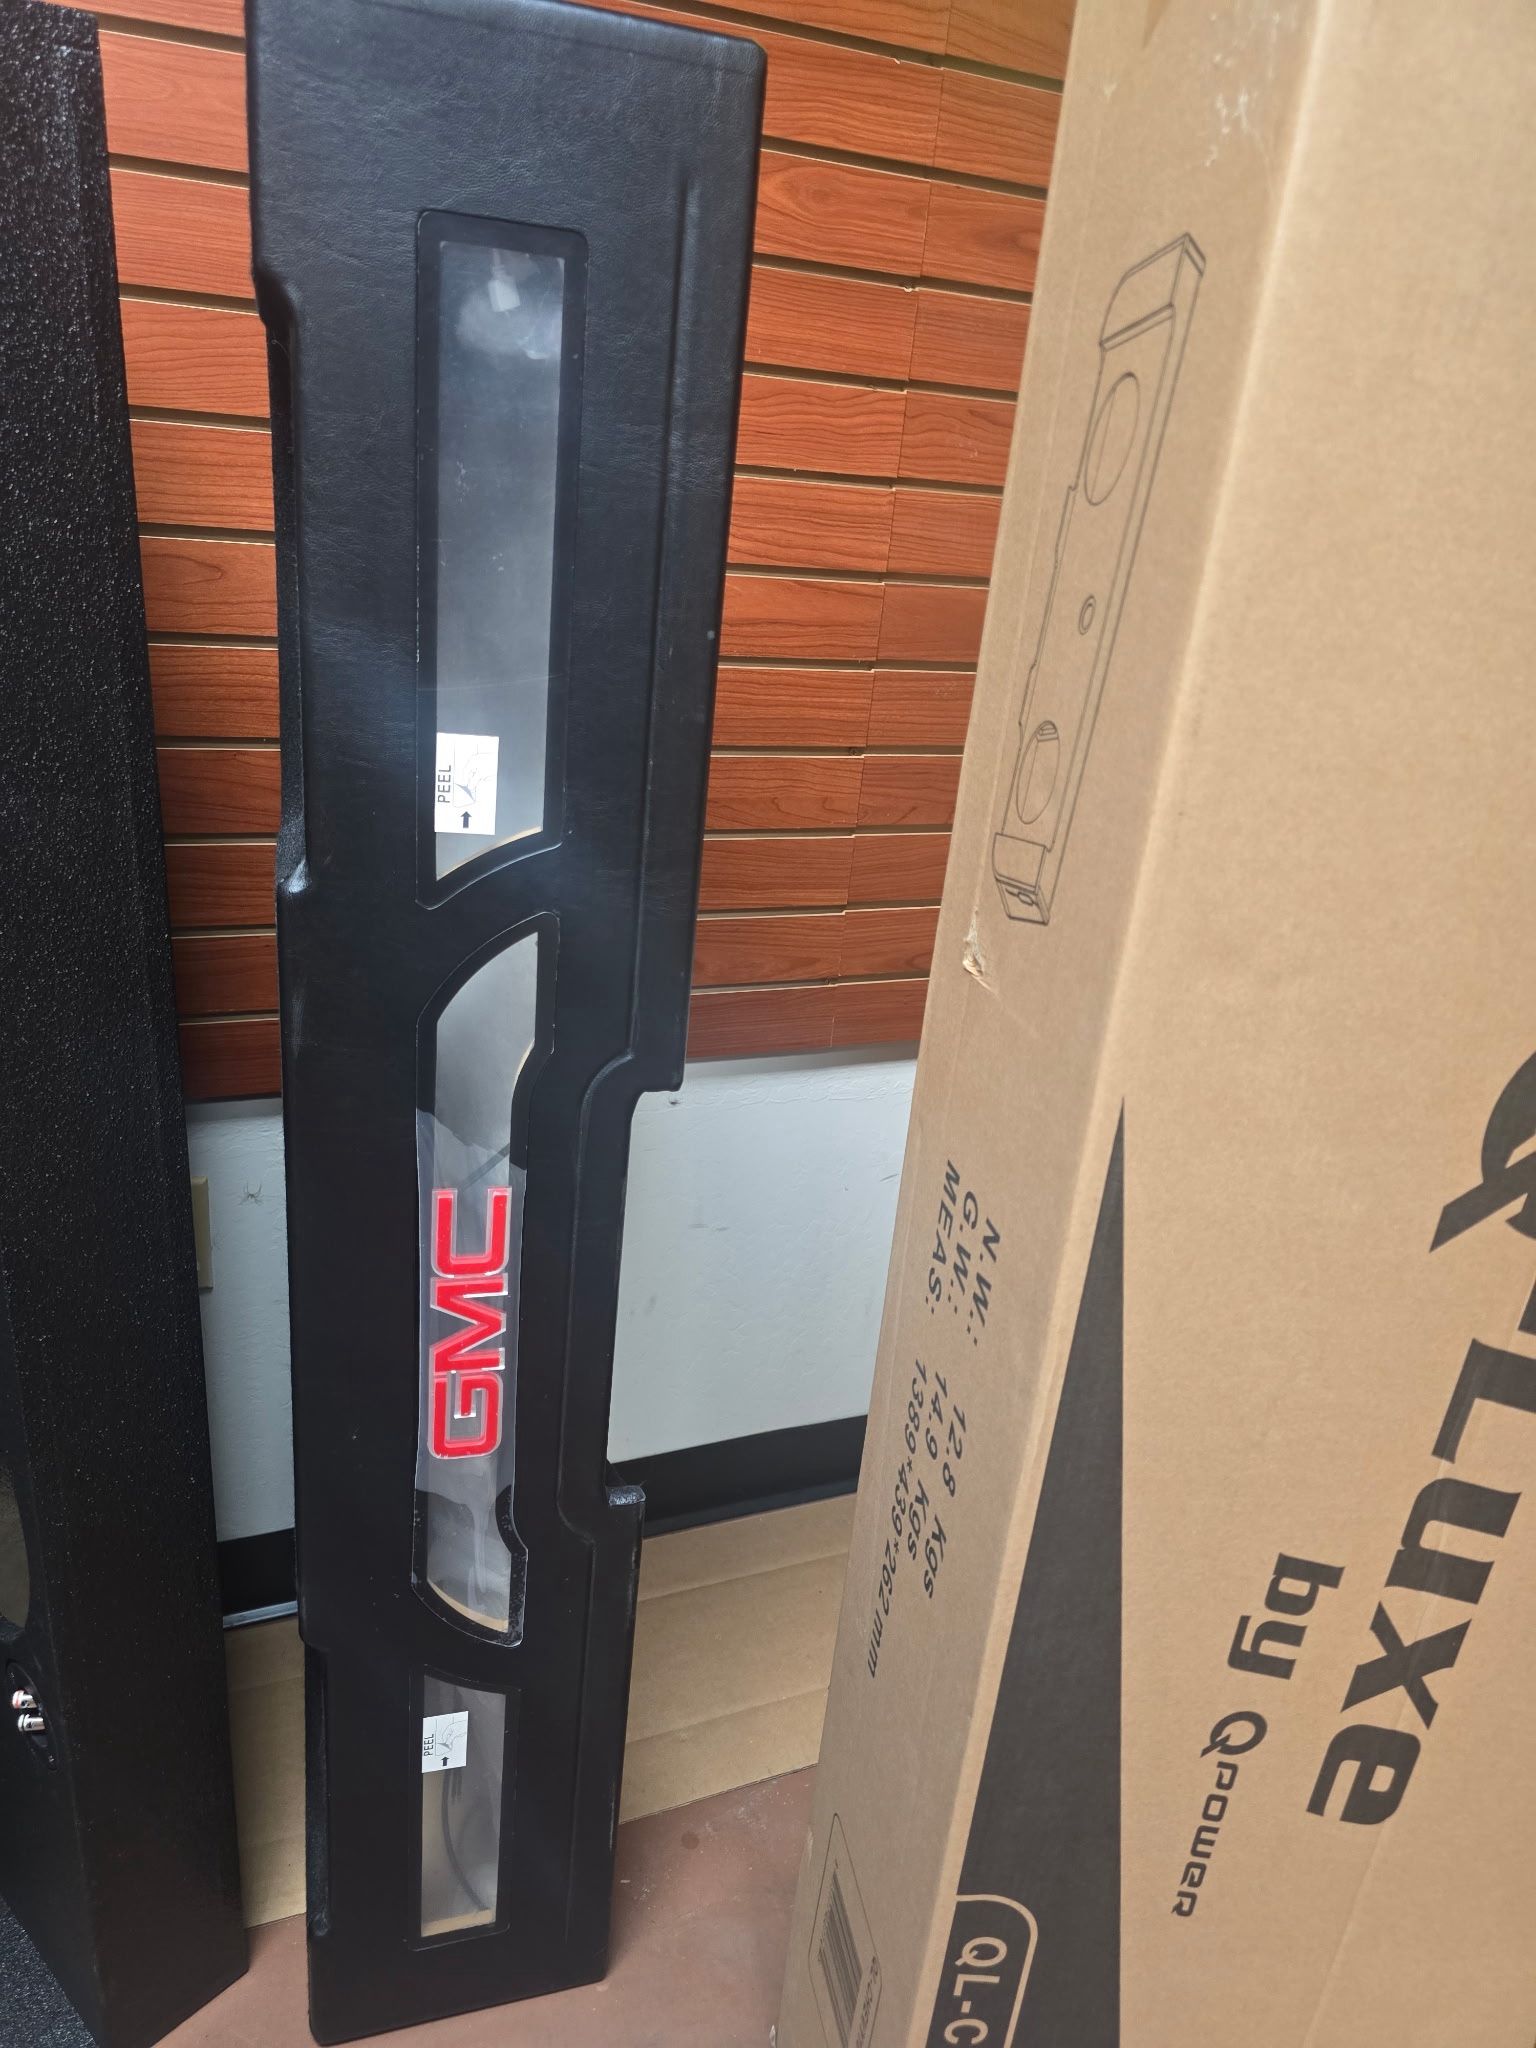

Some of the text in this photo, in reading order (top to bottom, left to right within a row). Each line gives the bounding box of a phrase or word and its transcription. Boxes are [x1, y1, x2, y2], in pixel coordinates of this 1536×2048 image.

[437, 764, 452, 804] PEEL
[926, 1159, 961, 1315] MEAS:
[428, 1186, 512, 1460] GMC
[907, 1190, 979, 1561] G.W.: 14.9 Kgs
[923, 1217, 1001, 1599] N.W.: 12.8 Kgs
[1227, 1552, 1346, 1681] by
[423, 1733, 435, 1757] PEEL
